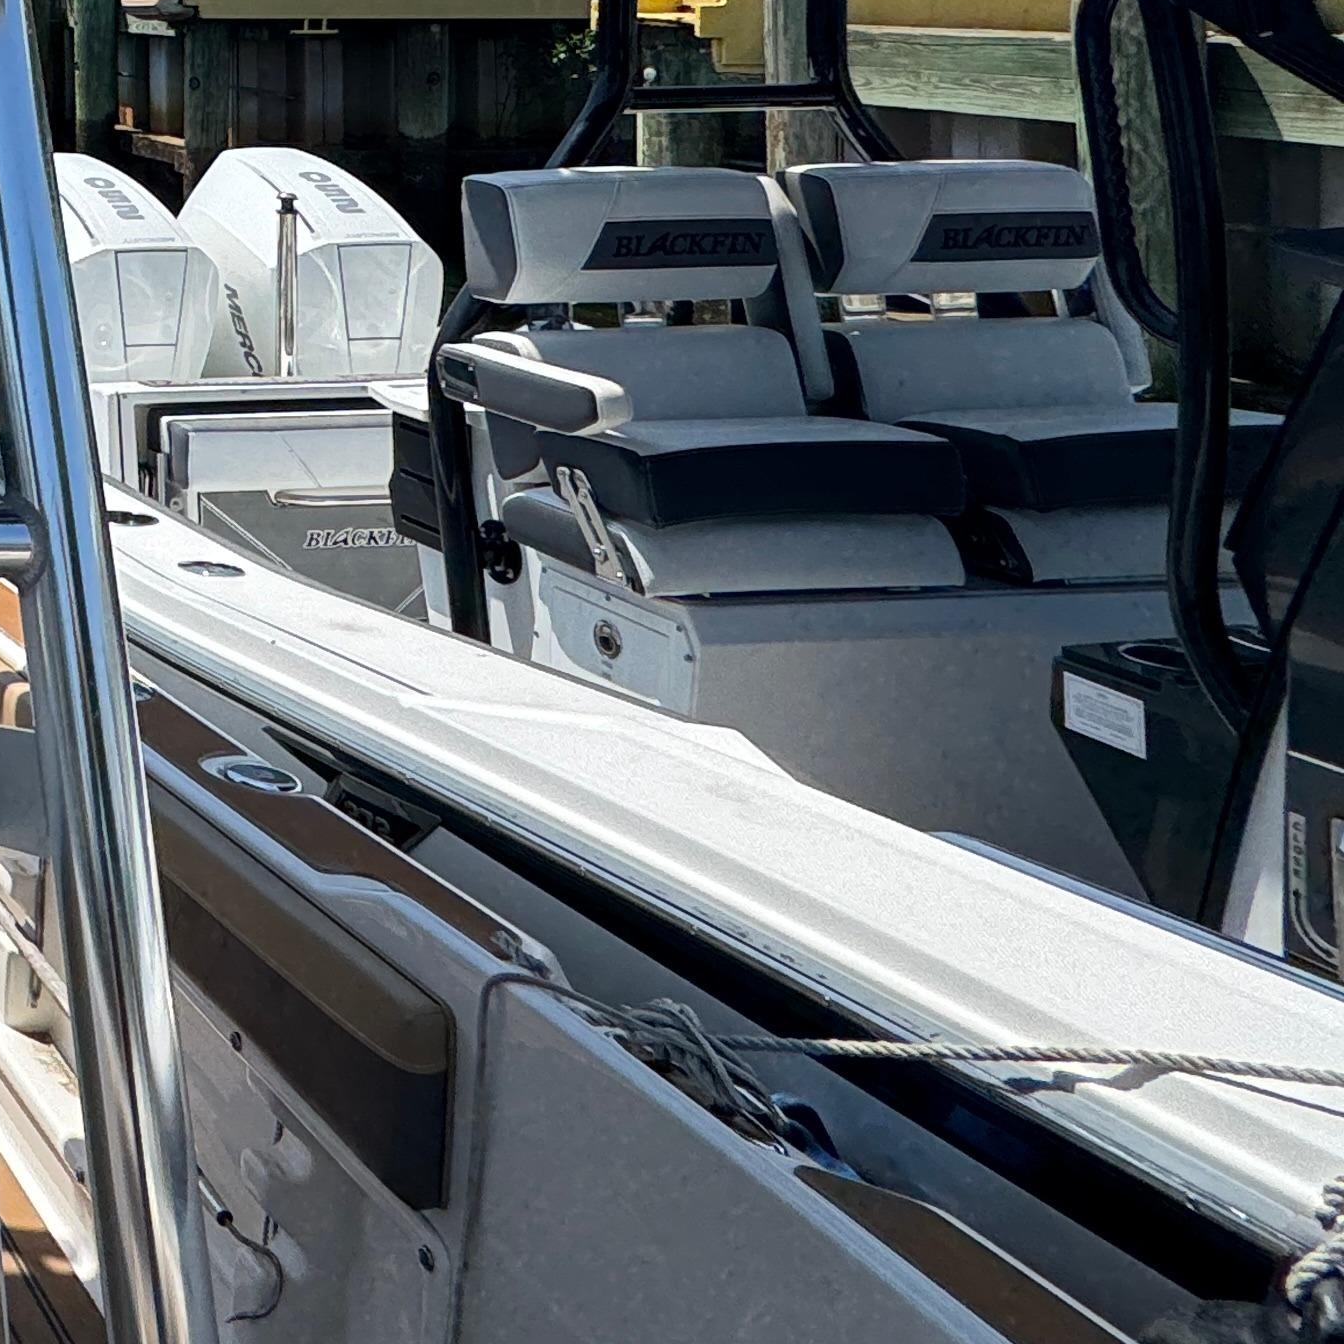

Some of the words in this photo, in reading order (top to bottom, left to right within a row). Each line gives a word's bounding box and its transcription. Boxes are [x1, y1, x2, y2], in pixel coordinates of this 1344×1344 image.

[612, 231, 767, 258] BLACKFIN
[941, 223, 1090, 250] BLACKFIN
[223, 282, 265, 377] MERC
